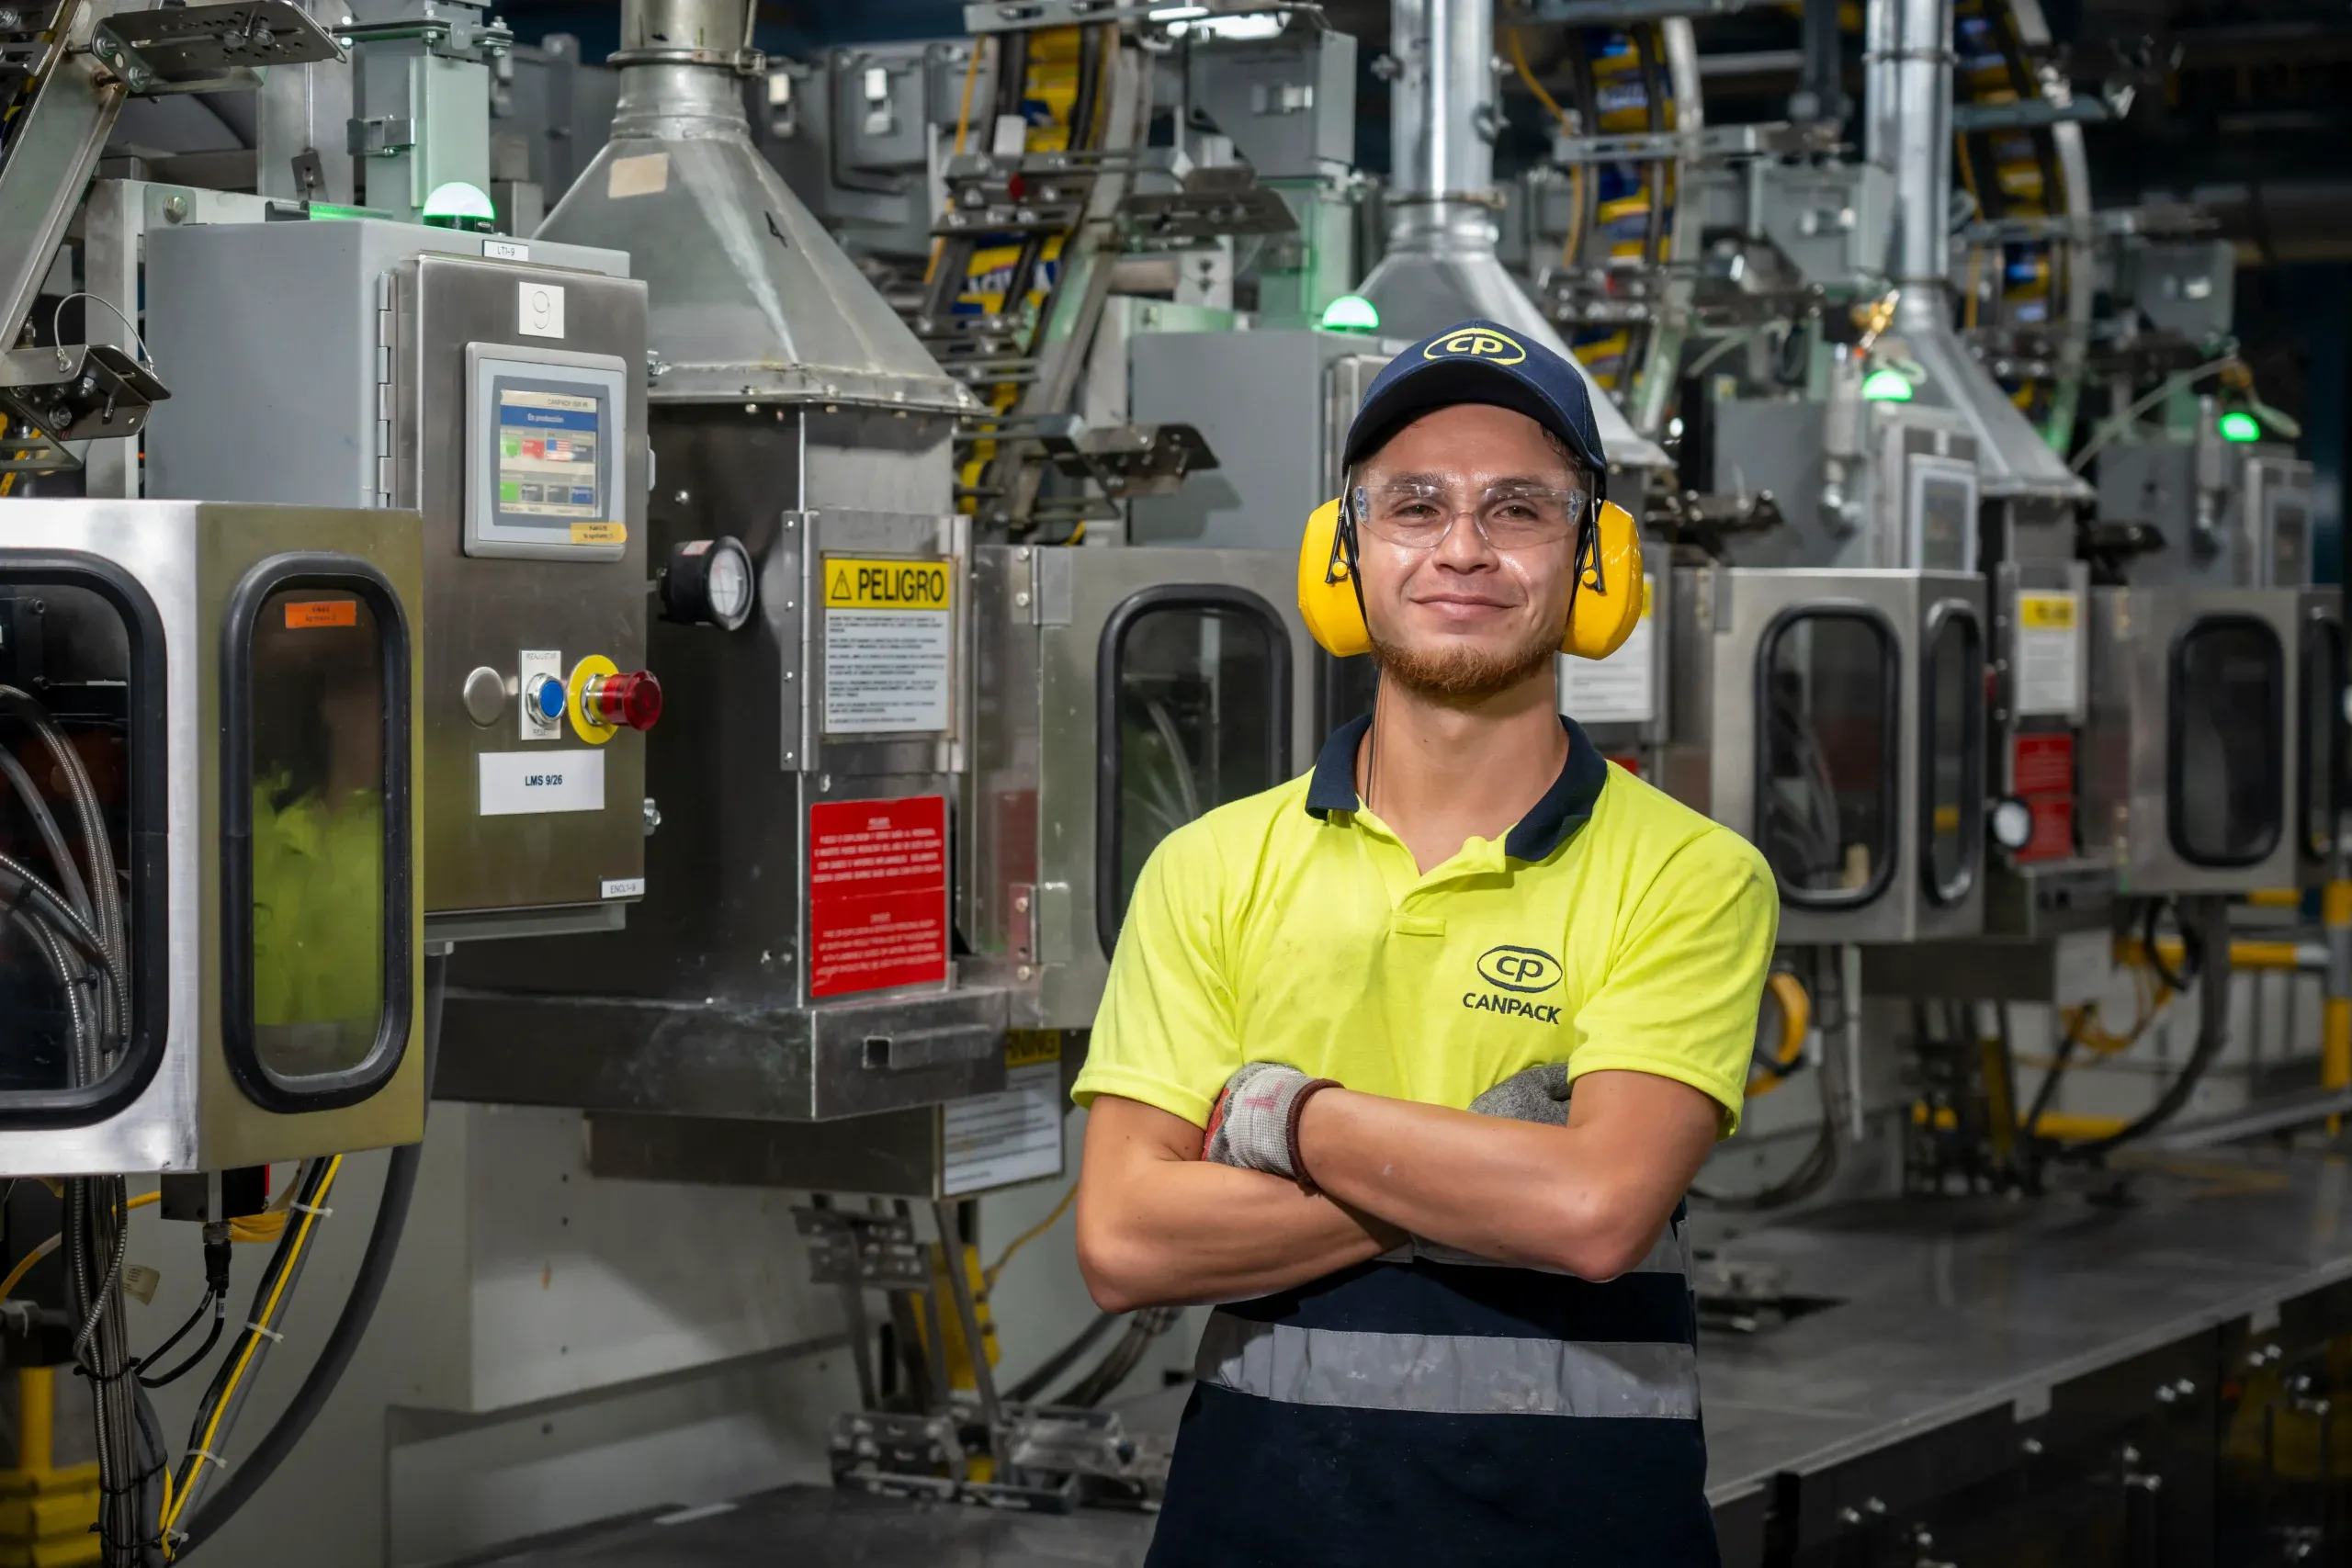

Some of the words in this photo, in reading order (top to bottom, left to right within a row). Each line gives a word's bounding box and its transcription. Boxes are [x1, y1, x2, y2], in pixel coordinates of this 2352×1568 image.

[533, 290, 549, 330] 9
[858, 568, 944, 603] PELIGRO
[525, 774, 544, 786] LMS
[546, 774, 563, 785] 9/26
[1462, 992, 1562, 1025] CANPACK
